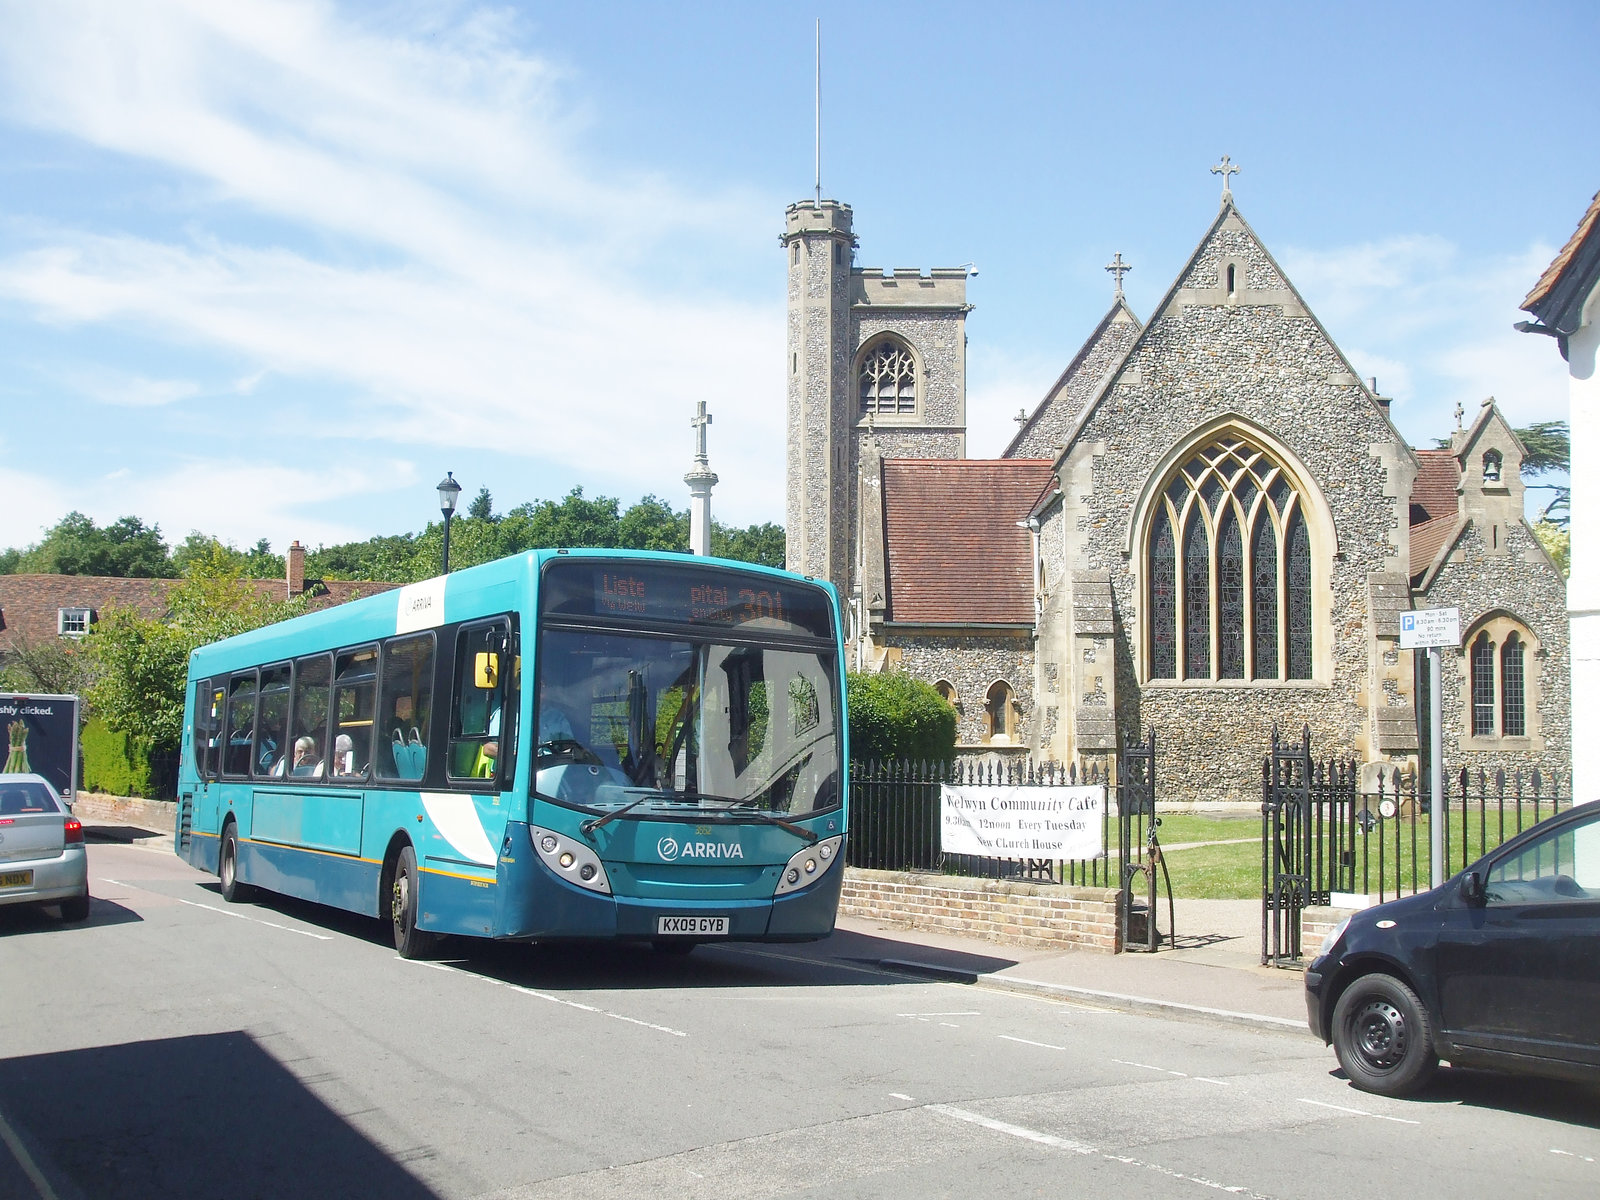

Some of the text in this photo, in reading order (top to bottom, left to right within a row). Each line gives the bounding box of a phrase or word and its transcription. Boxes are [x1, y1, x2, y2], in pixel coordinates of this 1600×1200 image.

[412, 596, 431, 612] ARRIVA
[738, 588, 785, 626] 301
[946, 794, 1098, 814] Welwyn Community Cafe
[979, 818, 1011, 830] 12noon
[1018, 819, 1042, 832] Every
[1044, 819, 1087, 832] Tuesday
[681, 842, 744, 858] ARRIVA
[977, 835, 1063, 850] New Church House
[663, 919, 724, 932] KX09 GYB
